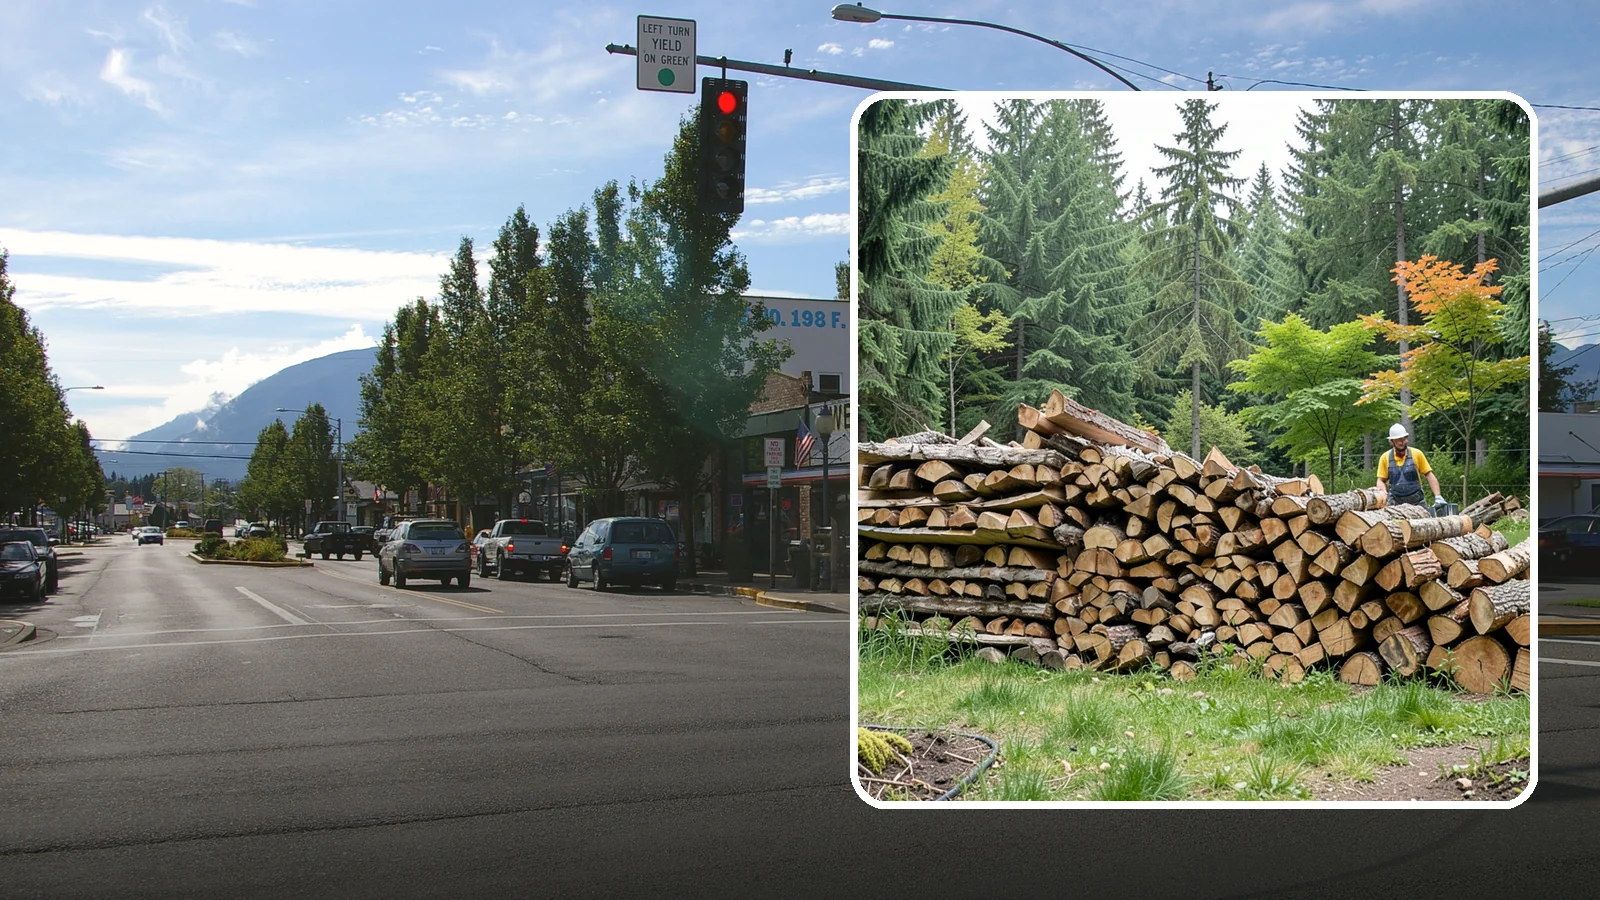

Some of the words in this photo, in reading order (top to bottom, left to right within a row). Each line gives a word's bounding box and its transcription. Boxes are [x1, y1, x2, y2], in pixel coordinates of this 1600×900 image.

[642, 23, 663, 34] LEFT
[668, 25, 690, 37] TURN
[652, 37, 682, 52] YIELD
[643, 53, 656, 64] ON
[660, 54, 690, 66] GREEN
[791, 309, 826, 328] 198
[831, 311, 846, 329] F.
